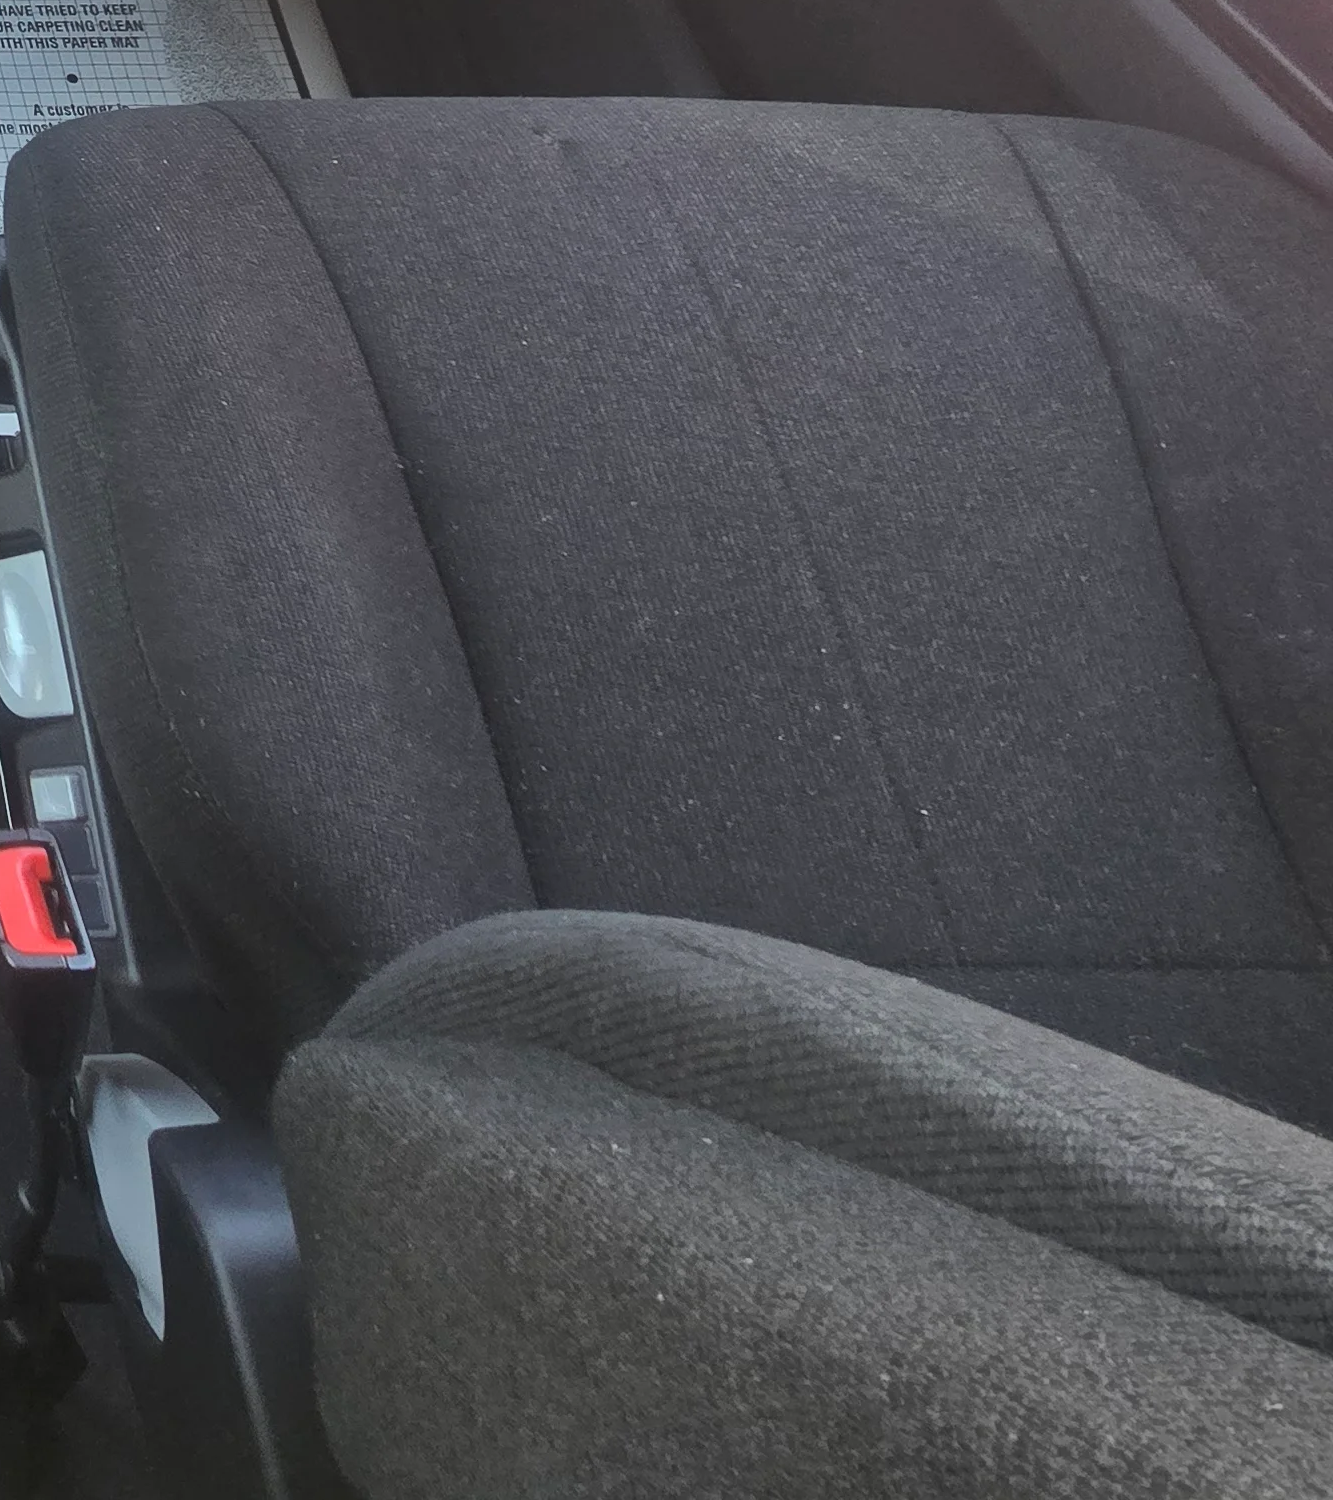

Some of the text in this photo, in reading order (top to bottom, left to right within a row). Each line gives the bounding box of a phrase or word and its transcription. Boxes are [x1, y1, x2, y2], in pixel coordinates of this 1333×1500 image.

[35, 4, 77, 16] TRIED
[80, 4, 99, 16] TO
[102, 4, 137, 16] KEEP
[17, 20, 95, 33] CARPETING
[98, 20, 144, 32] CLEAN
[26, 37, 59, 49] THIS
[63, 37, 107, 49] PAPER
[111, 36, 140, 48] MAT
[33, 104, 44, 116] A
